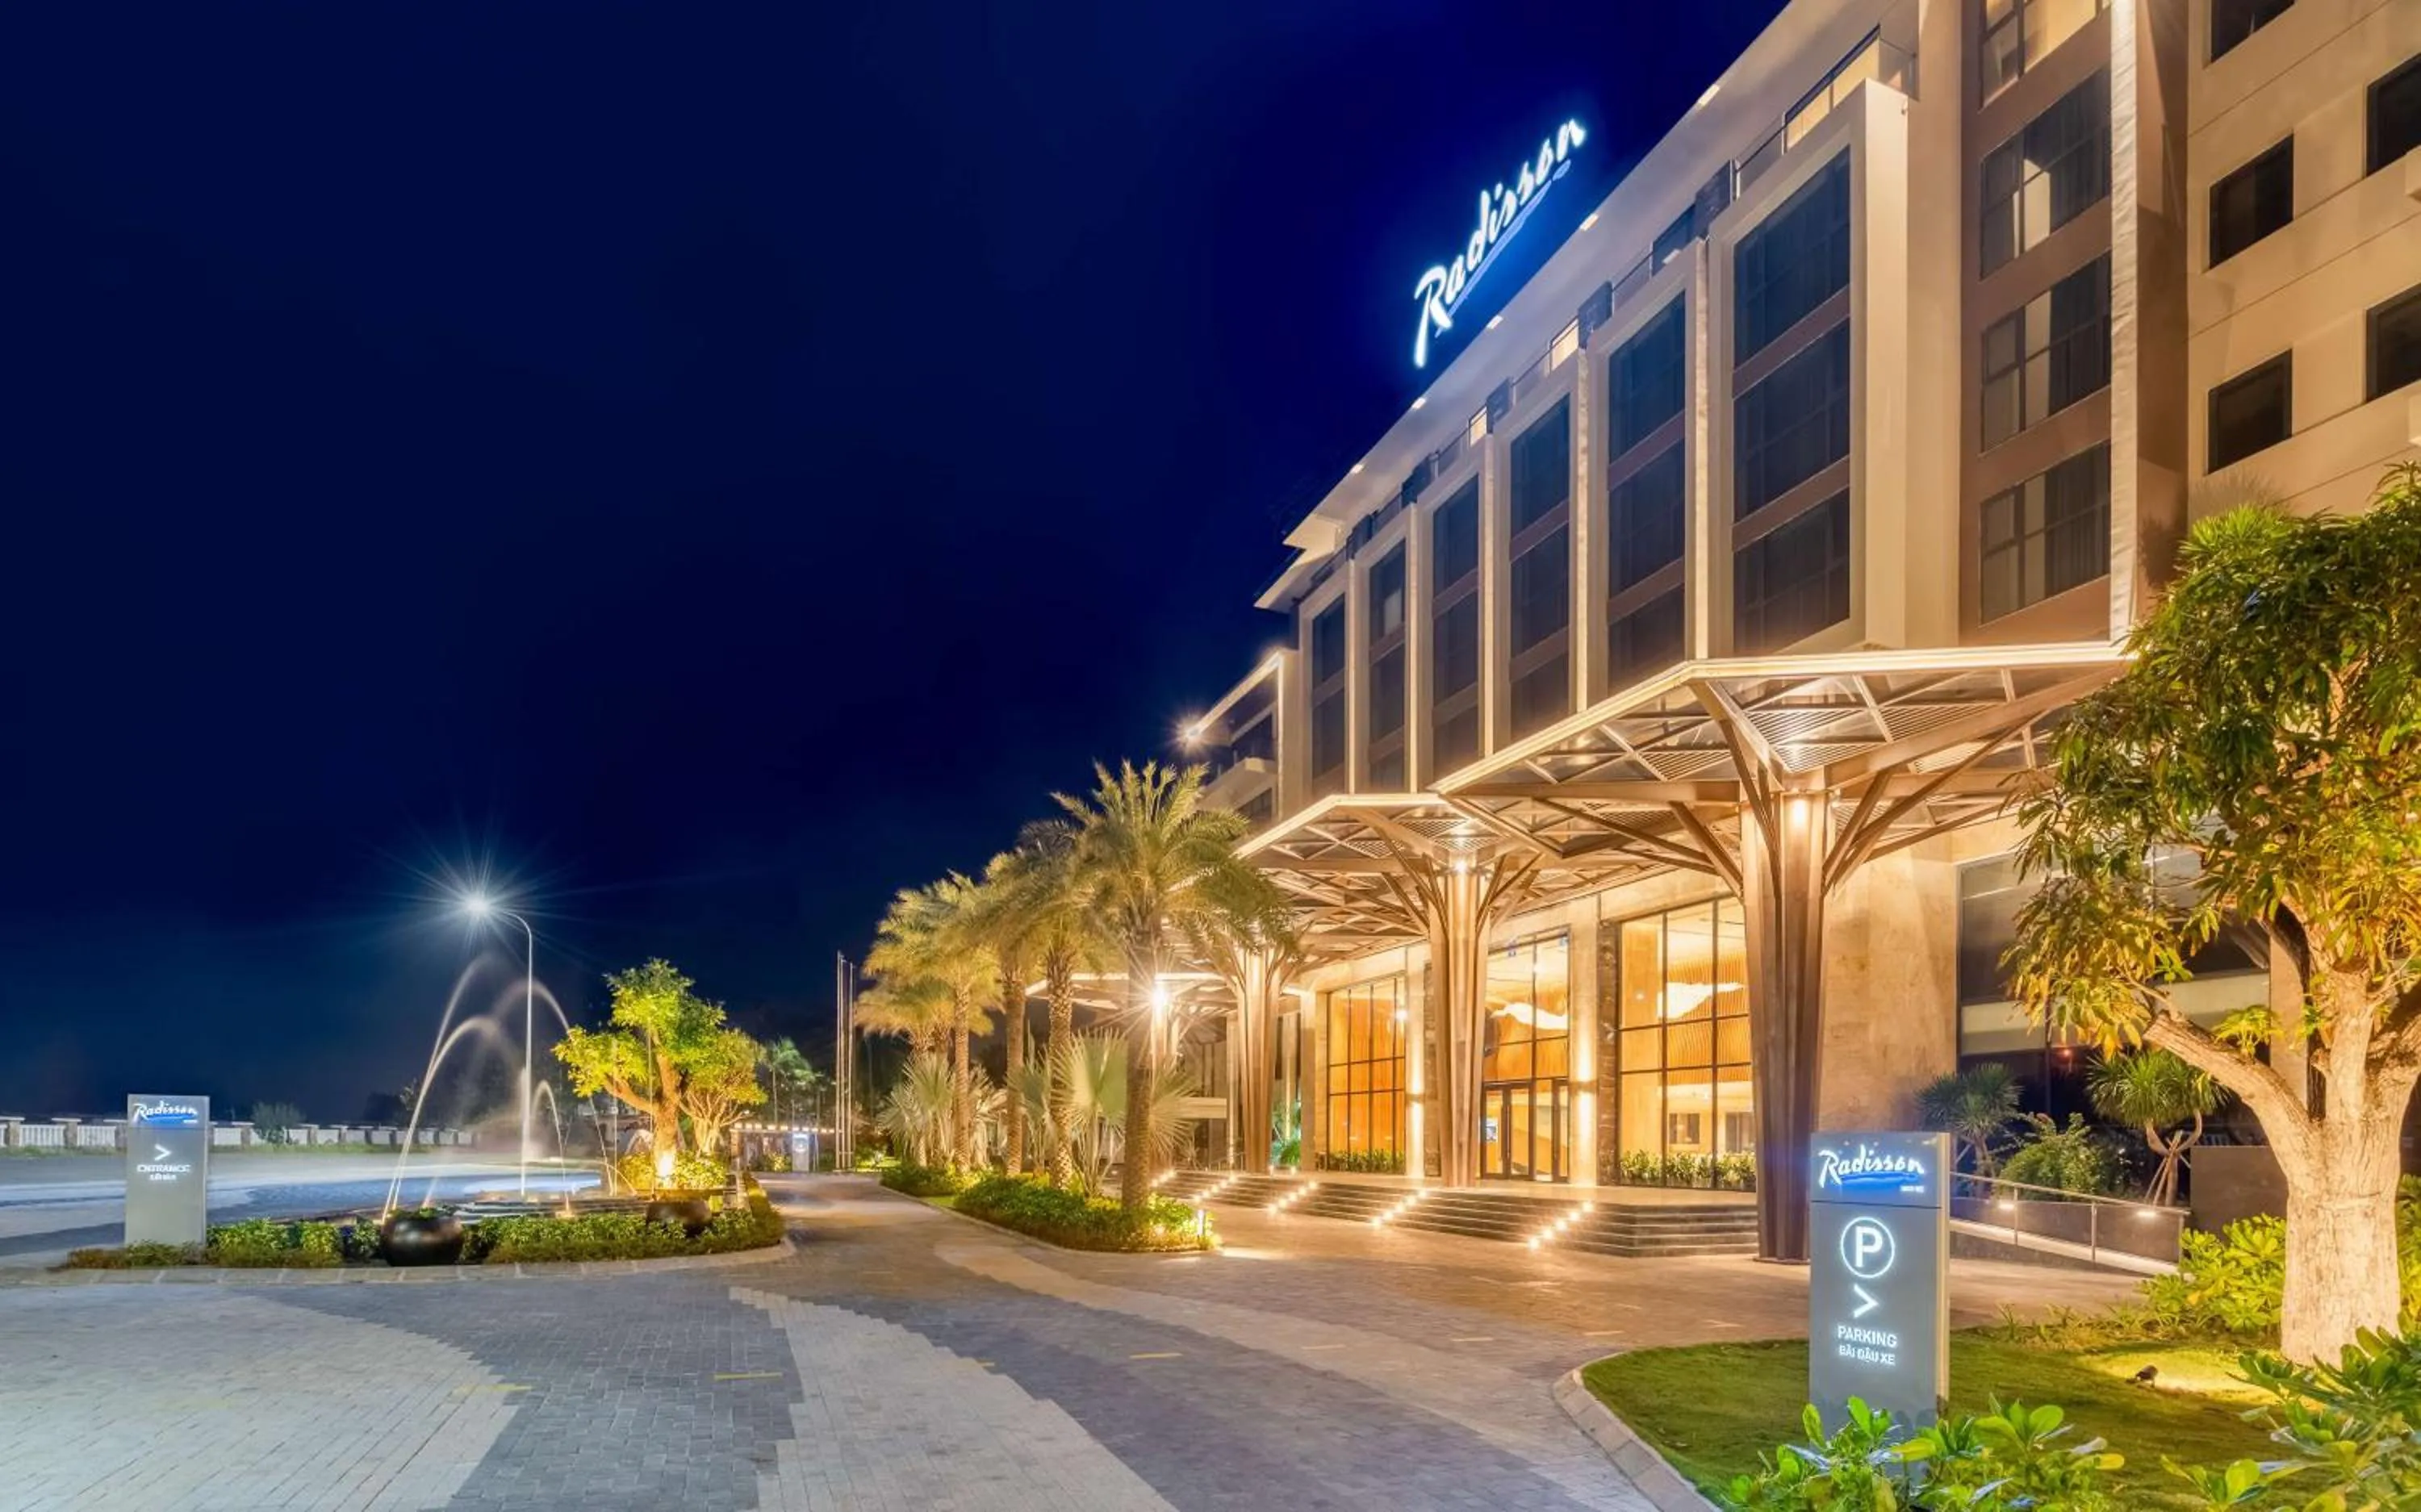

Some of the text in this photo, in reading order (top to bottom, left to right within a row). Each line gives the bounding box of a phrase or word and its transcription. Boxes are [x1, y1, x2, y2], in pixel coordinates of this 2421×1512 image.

[1414, 118, 1587, 368] Radisson
[133, 1101, 198, 1122] Radisson
[1817, 1144, 1925, 1188] Radisson
[1855, 1226, 1884, 1268] P
[1838, 1326, 1897, 1347] PARKING
[1880, 1352, 1896, 1366] XE
